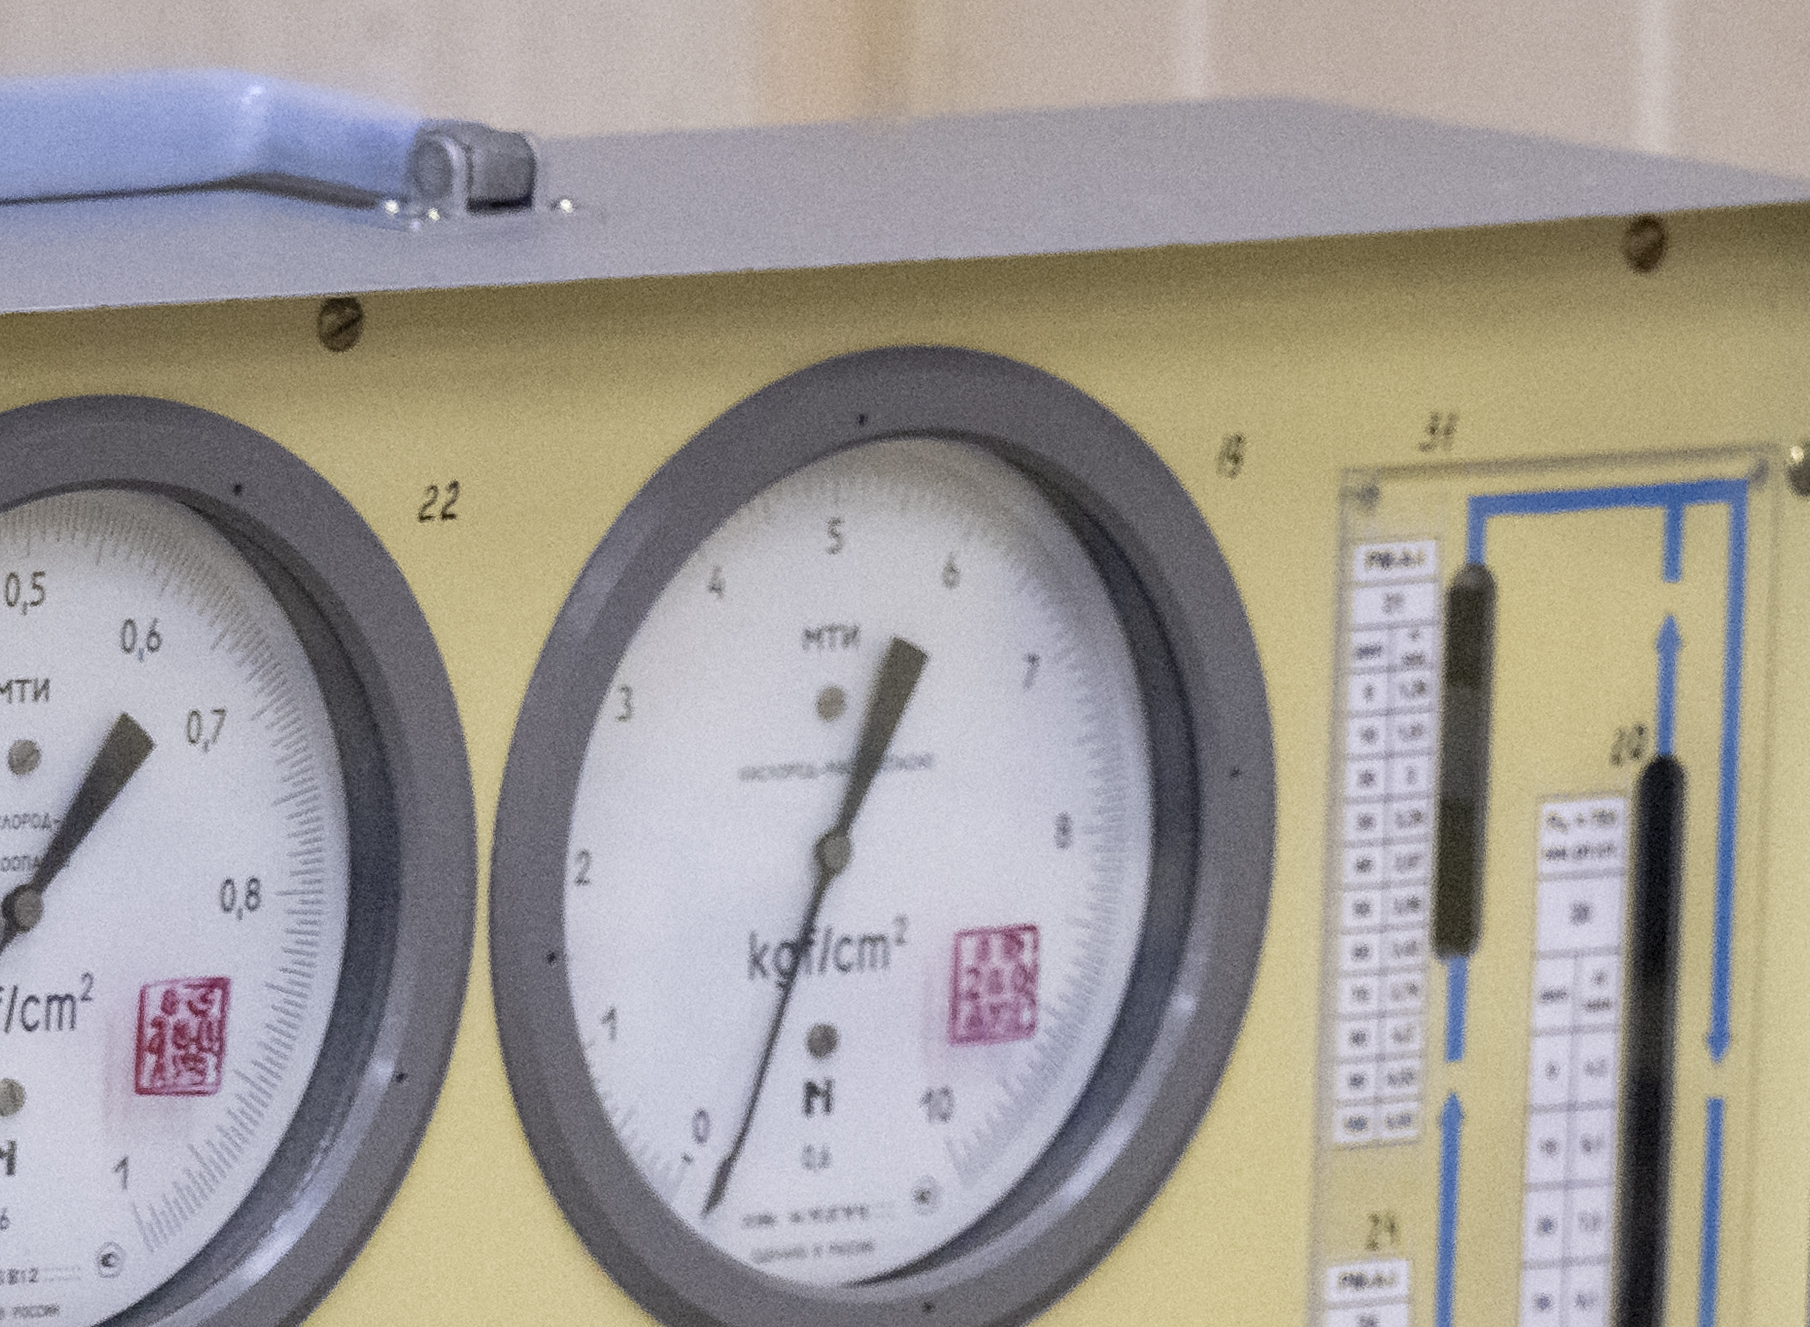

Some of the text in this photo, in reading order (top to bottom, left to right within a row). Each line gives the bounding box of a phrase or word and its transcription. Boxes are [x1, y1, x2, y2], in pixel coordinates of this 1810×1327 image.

[417, 480, 460, 523] 22
[826, 516, 845, 555] 5
[707, 565, 725, 598] 4
[941, 552, 961, 590] 6
[3, 570, 47, 616] 0,5
[120, 617, 163, 662] 0,6
[1025, 653, 1041, 688] 7
[615, 683, 634, 723] 3
[185, 707, 228, 753] 0,7
[573, 849, 592, 887] 2
[219, 876, 262, 920] 0,8
[601, 1007, 617, 1041] 1
[920, 1085, 954, 1123] 10
[692, 1108, 711, 1145] 0
[113, 1155, 129, 1190] 1
